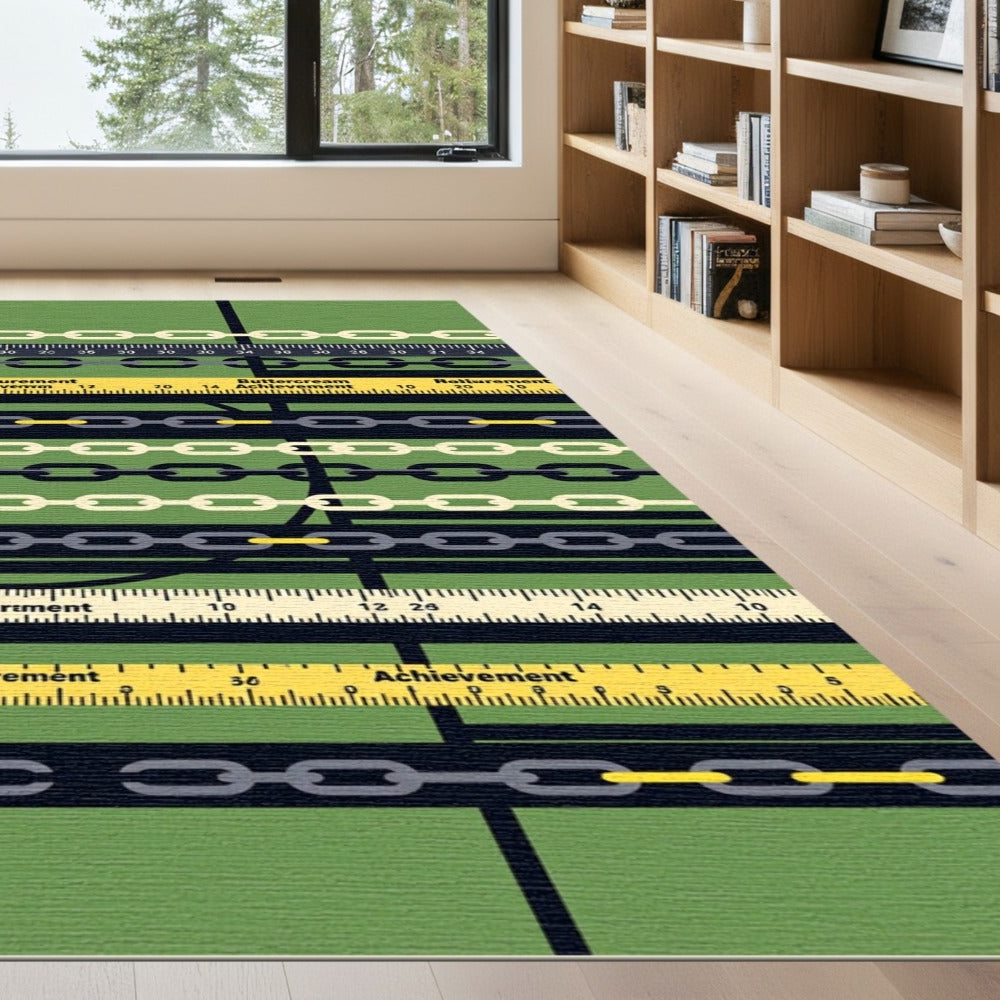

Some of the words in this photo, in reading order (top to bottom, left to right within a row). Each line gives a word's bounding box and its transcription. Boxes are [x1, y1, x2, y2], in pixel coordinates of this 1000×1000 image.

[207, 603, 236, 611] 10
[358, 603, 389, 611] 12
[571, 603, 602, 611] 14
[736, 603, 768, 611] 10
[374, 670, 578, 682] Achievement
